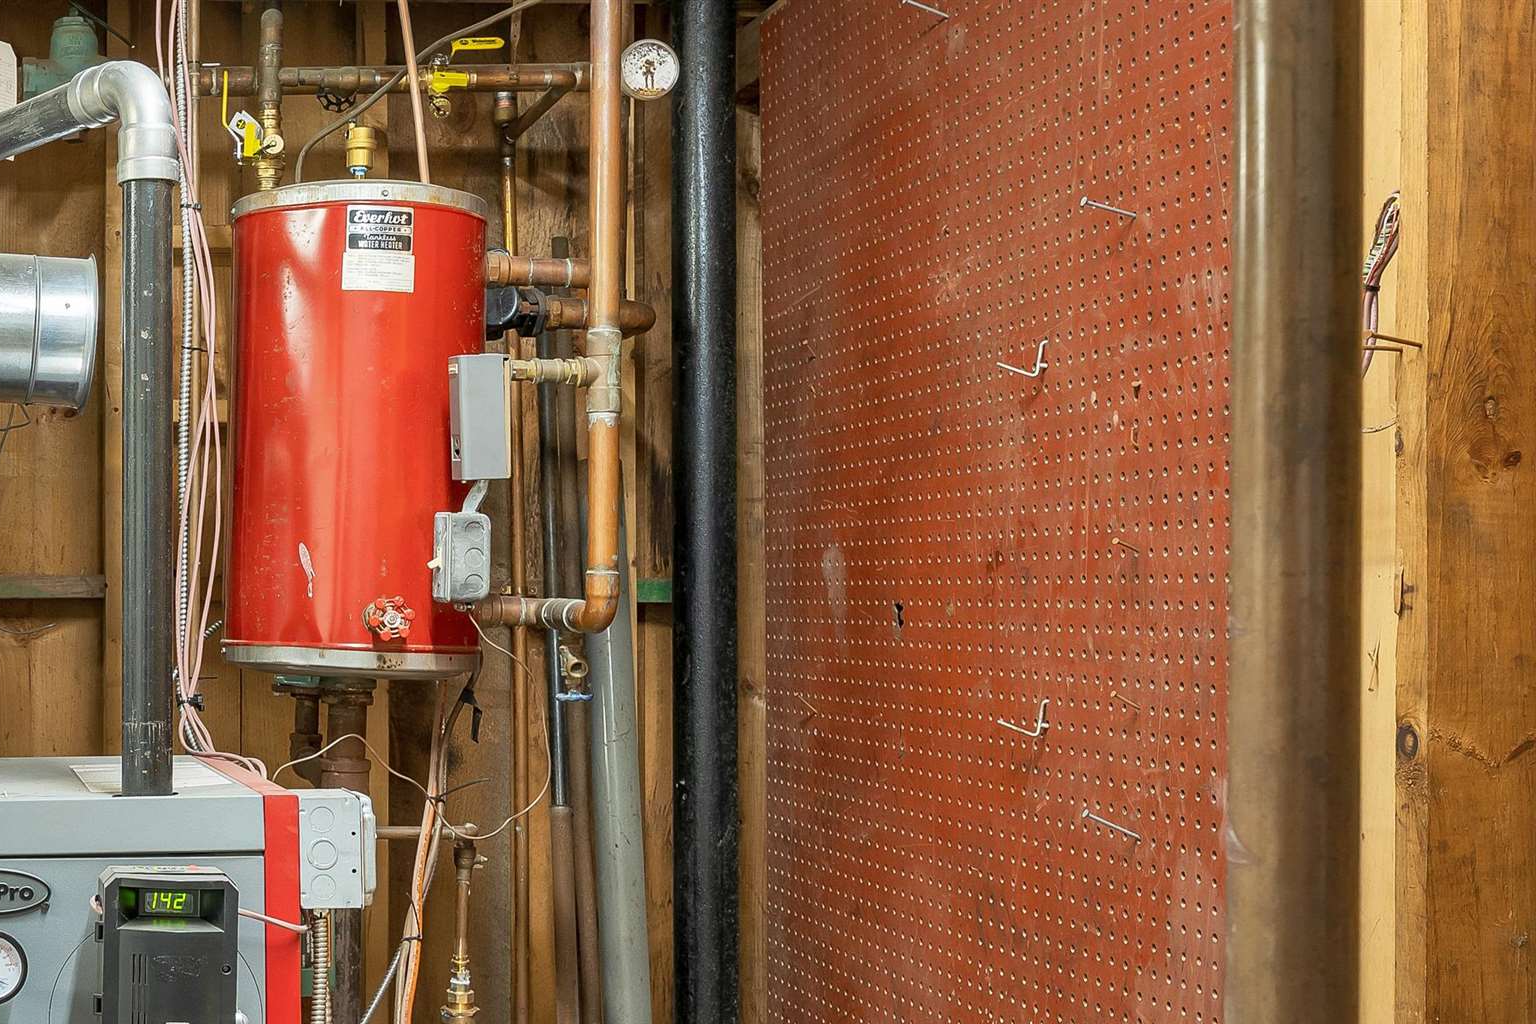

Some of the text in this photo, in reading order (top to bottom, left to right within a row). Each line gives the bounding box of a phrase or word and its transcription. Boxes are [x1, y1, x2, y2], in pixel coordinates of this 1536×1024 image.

[353, 209, 409, 225] Everhot
[358, 240, 403, 250] WATER HEATER
[151, 891, 187, 910] 142
